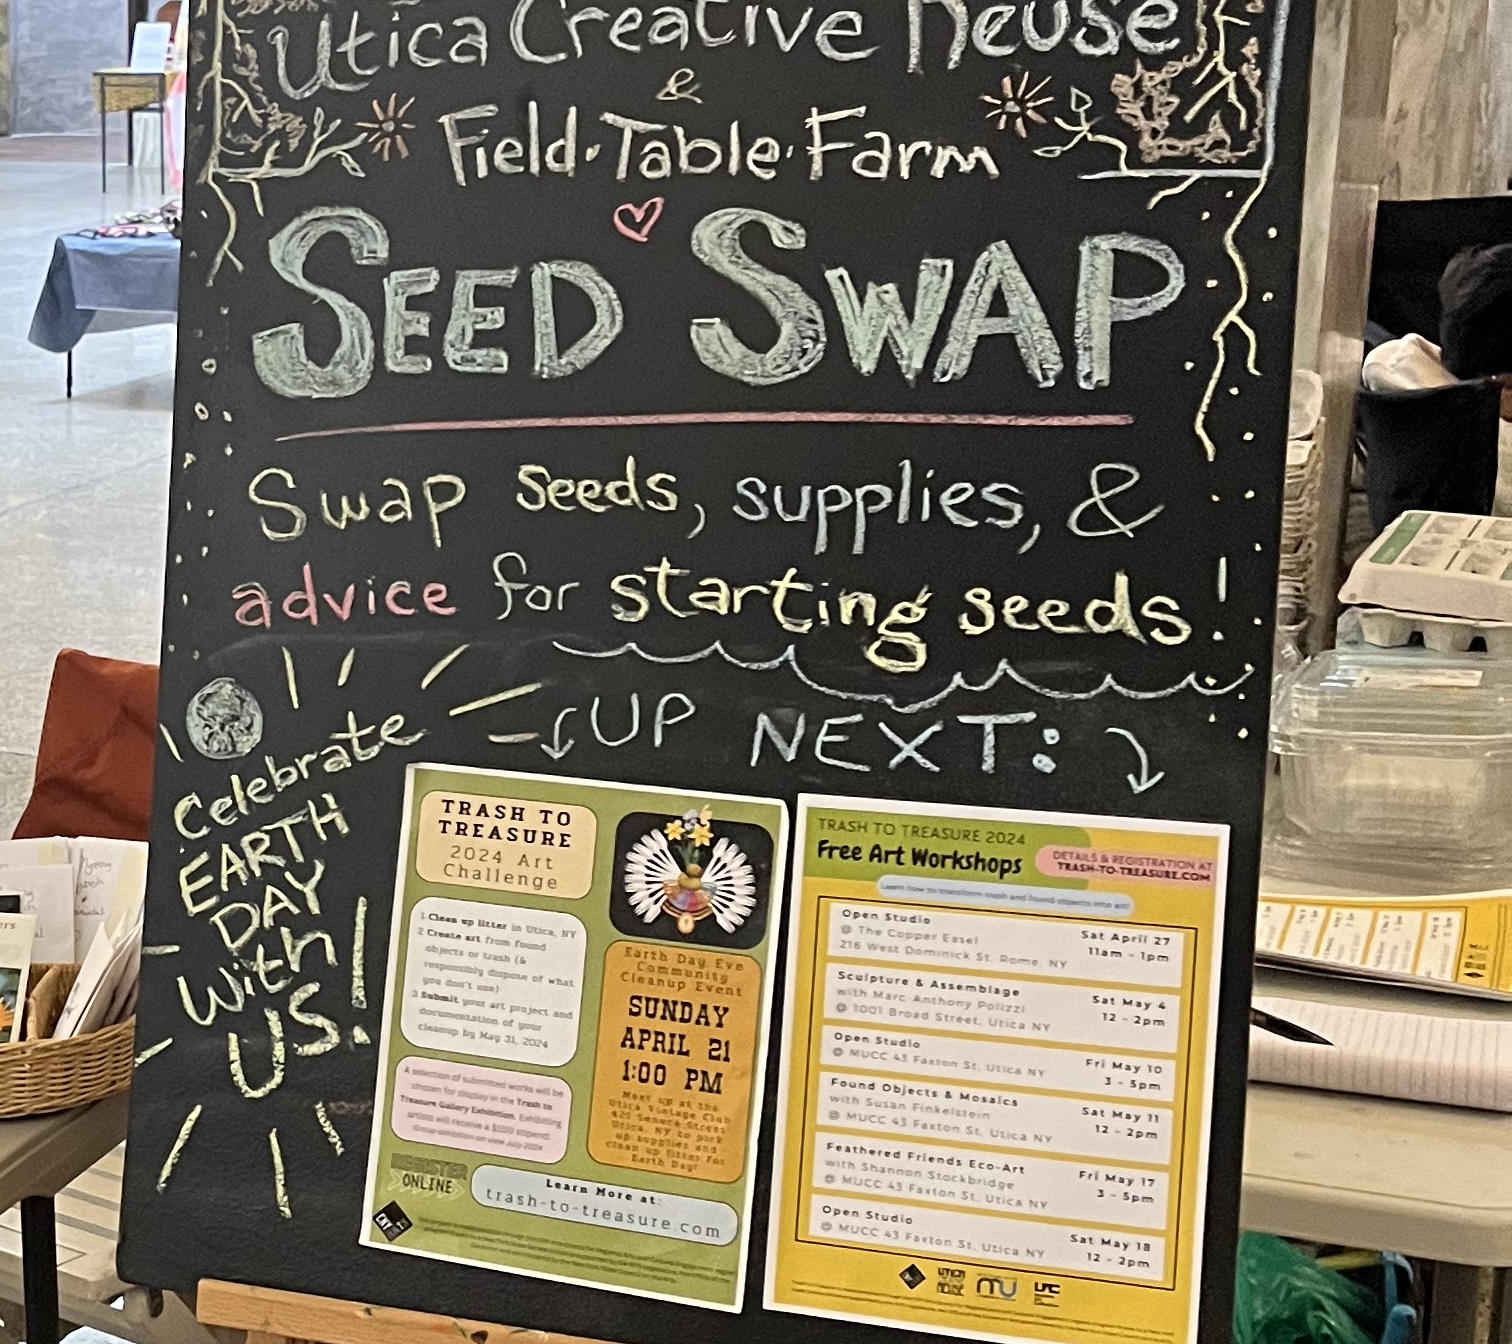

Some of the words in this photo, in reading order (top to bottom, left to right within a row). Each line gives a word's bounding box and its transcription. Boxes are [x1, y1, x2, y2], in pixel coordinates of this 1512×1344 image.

[655, 68, 703, 103] &
[515, 456, 705, 539] seeds,
[732, 461, 1041, 553] supplies,
[1067, 463, 1165, 538] &
[233, 564, 458, 631] advice
[495, 552, 580, 621] for
[610, 560, 930, 672] starting
[958, 558, 1232, 645] seeds!
[588, 694, 697, 749] UP
[752, 711, 1059, 773] NEXT:
[173, 711, 431, 840] Celebrate
[442, 799, 525, 821] TRASH
[539, 810, 571, 826] TO
[438, 820, 571, 848] TREASURE
[818, 818, 868, 834] TRASH
[873, 822, 896, 836] TO
[902, 824, 981, 842] TREASURE
[986, 831, 1026, 846] 2024
[178, 792, 349, 916] EARTH
[451, 845, 502, 864] 2024
[517, 854, 553, 870] Art
[818, 840, 863, 861] Free
[869, 844, 905, 866] Art
[912, 847, 1023, 879] Workshops
[1053, 850, 1098, 863] DETAILS
[1112, 855, 1195, 870] REGISTRATION
[1200, 862, 1214, 871] AT
[443, 863, 558, 890] Challenge
[1058, 862, 1210, 882] TRASH-TO-TREASURE.COM
[210, 859, 324, 956] DAY
[842, 909, 879, 920] Open
[884, 912, 931, 925] Studio
[428, 913, 458, 924] Clean
[461, 919, 474, 927] up
[478, 919, 507, 930] litter
[511, 924, 522, 932] in
[561, 929, 576, 939] NY
[1081, 931, 1104, 941] Sat
[1111, 933, 1148, 944] April
[1154, 937, 1171, 946] 27
[427, 929, 461, 940] Create
[465, 935, 481, 943] art
[485, 936, 511, 946] from
[515, 940, 546, 951] found
[624, 947, 668, 962] Earth
[677, 953, 706, 968] Day
[715, 959, 744, 971] Eve
[1088, 947, 1122, 957] 11am
[1141, 951, 1169, 963] 1pm
[620, 971, 686, 992] Cleanup
[695, 982, 742, 997] Event
[637, 961, 729, 984] Community
[838, 971, 909, 986] Sculpture
[915, 979, 924, 987] &
[930, 980, 1020, 998] Assemblage
[228, 896, 372, 1100] US!
[421, 991, 459, 1004] Submit
[462, 998, 485, 1007] your
[490, 1001, 506, 1010] art
[509, 1004, 548, 1017] project
[553, 1011, 573, 1019] and
[628, 995, 729, 1028] SUNDAY
[1092, 996, 1116, 1005] Sat
[1122, 998, 1152, 1011] May
[620, 1027, 690, 1057] APRIL
[708, 1038, 731, 1062] 21
[834, 1032, 870, 1043] Open
[876, 1037, 921, 1049] Studio
[623, 1059, 666, 1086] 1:00
[684, 1068, 723, 1094] PM
[1085, 1059, 1106, 1068] Fri
[1112, 1062, 1141, 1073] May
[1147, 1065, 1162, 1074] 10
[830, 1078, 875, 1091] Found
[882, 1083, 938, 1097] Objects
[944, 1091, 953, 1099] &
[960, 1092, 1019, 1107] Mosaics
[1082, 1107, 1105, 1117] Sat
[1112, 1111, 1141, 1123] May
[1148, 1114, 1159, 1123] 11
[826, 1142, 901, 1159] Feathered
[908, 1151, 963, 1166] Friends
[969, 1159, 1025, 1174] Eco-Art
[403, 1173, 452, 1193] ONLINE
[545, 1178, 588, 1194] Learn
[596, 1186, 635, 1200] More
[1079, 1171, 1099, 1181] Fri
[1105, 1174, 1134, 1186] May
[1142, 1178, 1155, 1187] 17
[485, 1187, 721, 1239] trash-to-treasure.com
[822, 1206, 859, 1218] Open
[866, 1211, 913, 1224] Studio
[1070, 1234, 1093, 1244] Sat
[1101, 1238, 1129, 1251] May
[1136, 1242, 1150, 1251] 18
